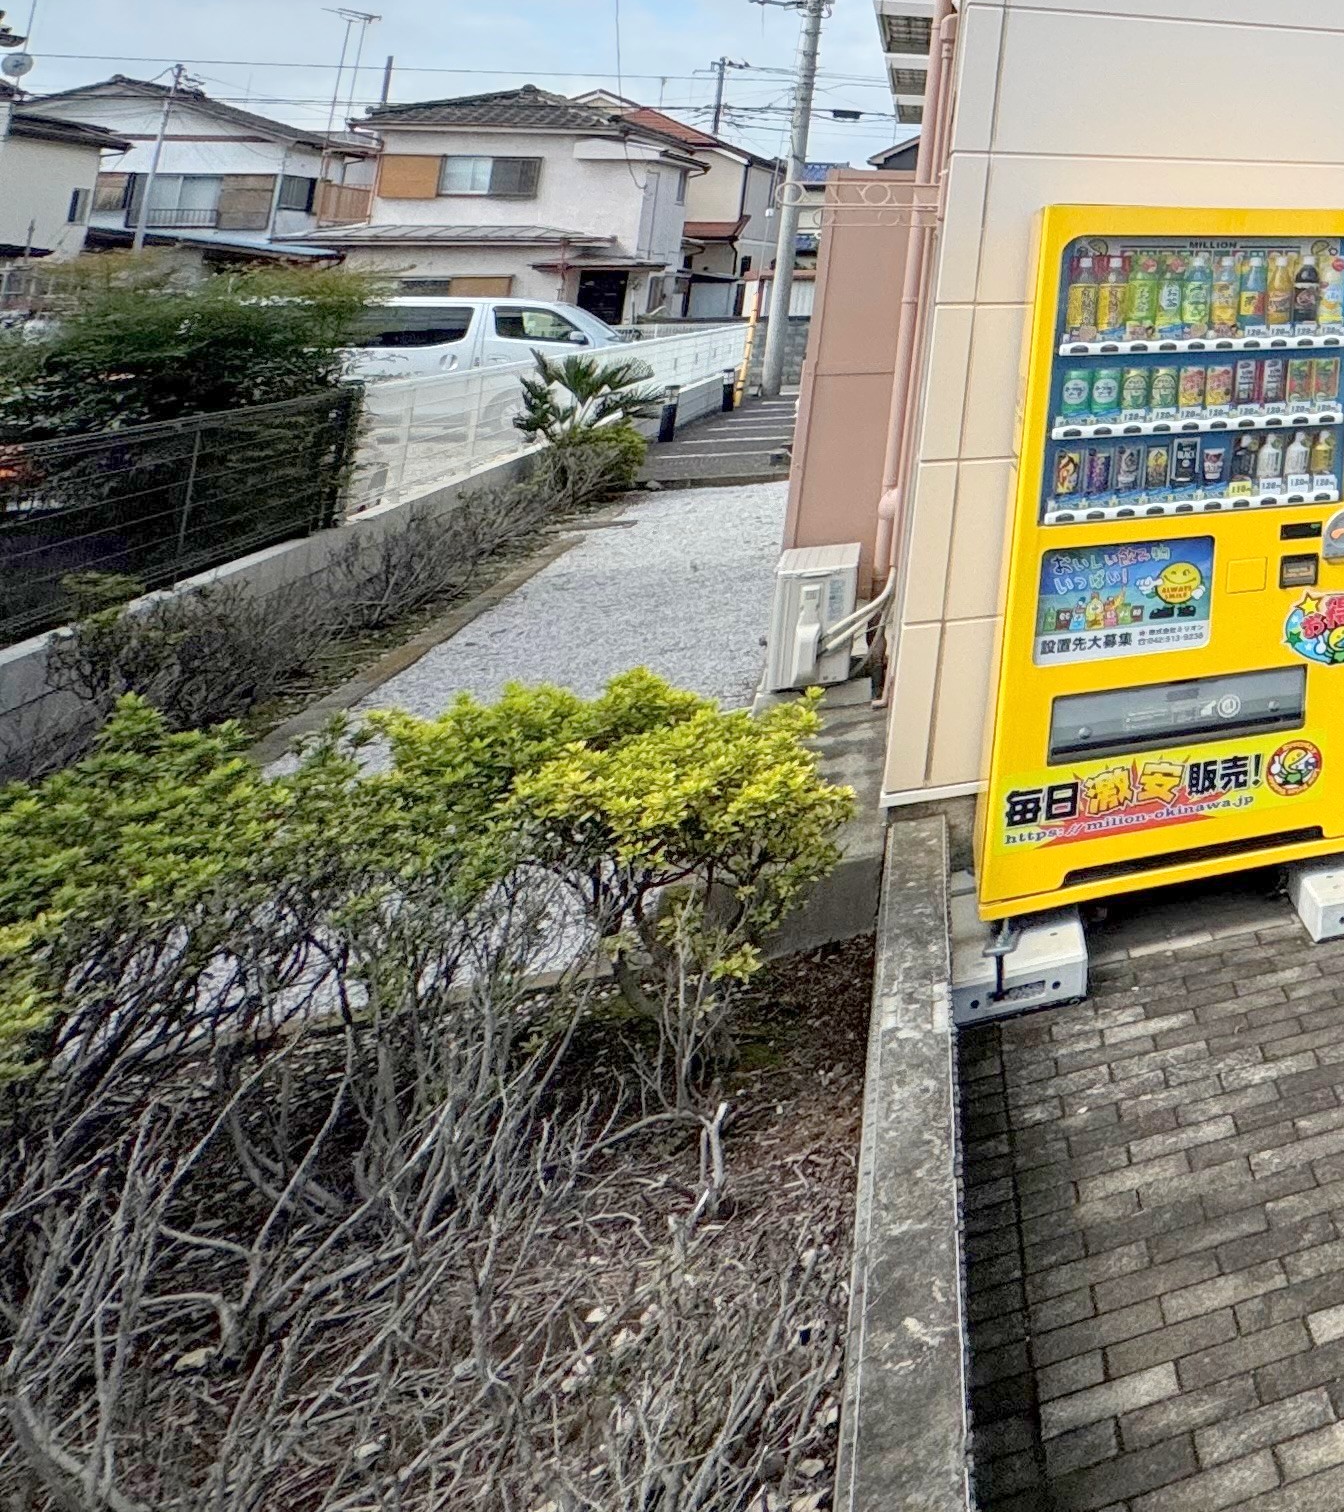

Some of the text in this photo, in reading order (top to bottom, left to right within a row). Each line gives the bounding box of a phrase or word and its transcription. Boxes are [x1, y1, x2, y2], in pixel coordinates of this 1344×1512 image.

[1189, 240, 1237, 249] MILLION
[1050, 544, 1171, 575] おいしい飲み物
[1040, 632, 1133, 656] 設置先大募集
[1004, 752, 1264, 827] 毎日激安販売!
